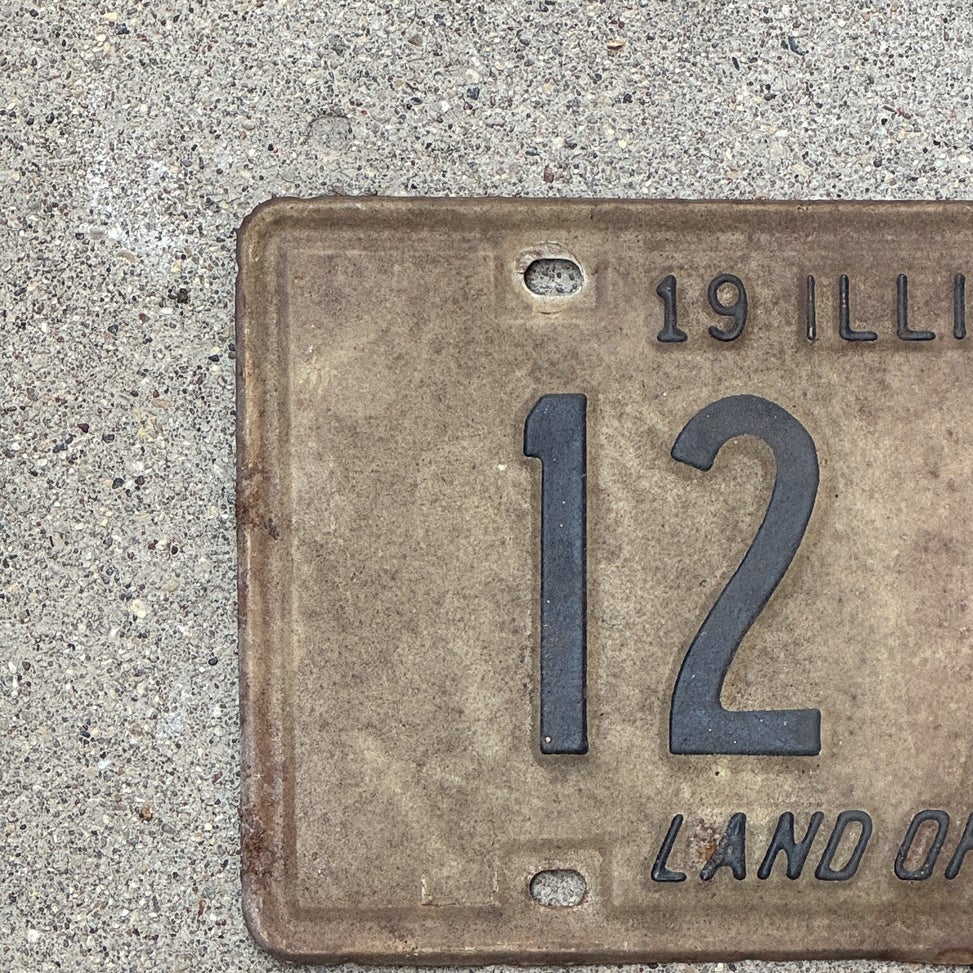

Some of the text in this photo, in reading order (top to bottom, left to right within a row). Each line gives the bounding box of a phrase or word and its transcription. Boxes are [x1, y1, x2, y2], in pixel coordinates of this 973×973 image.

[655, 273, 749, 342] 19
[523, 393, 822, 755] 12
[651, 810, 873, 882] LAND
